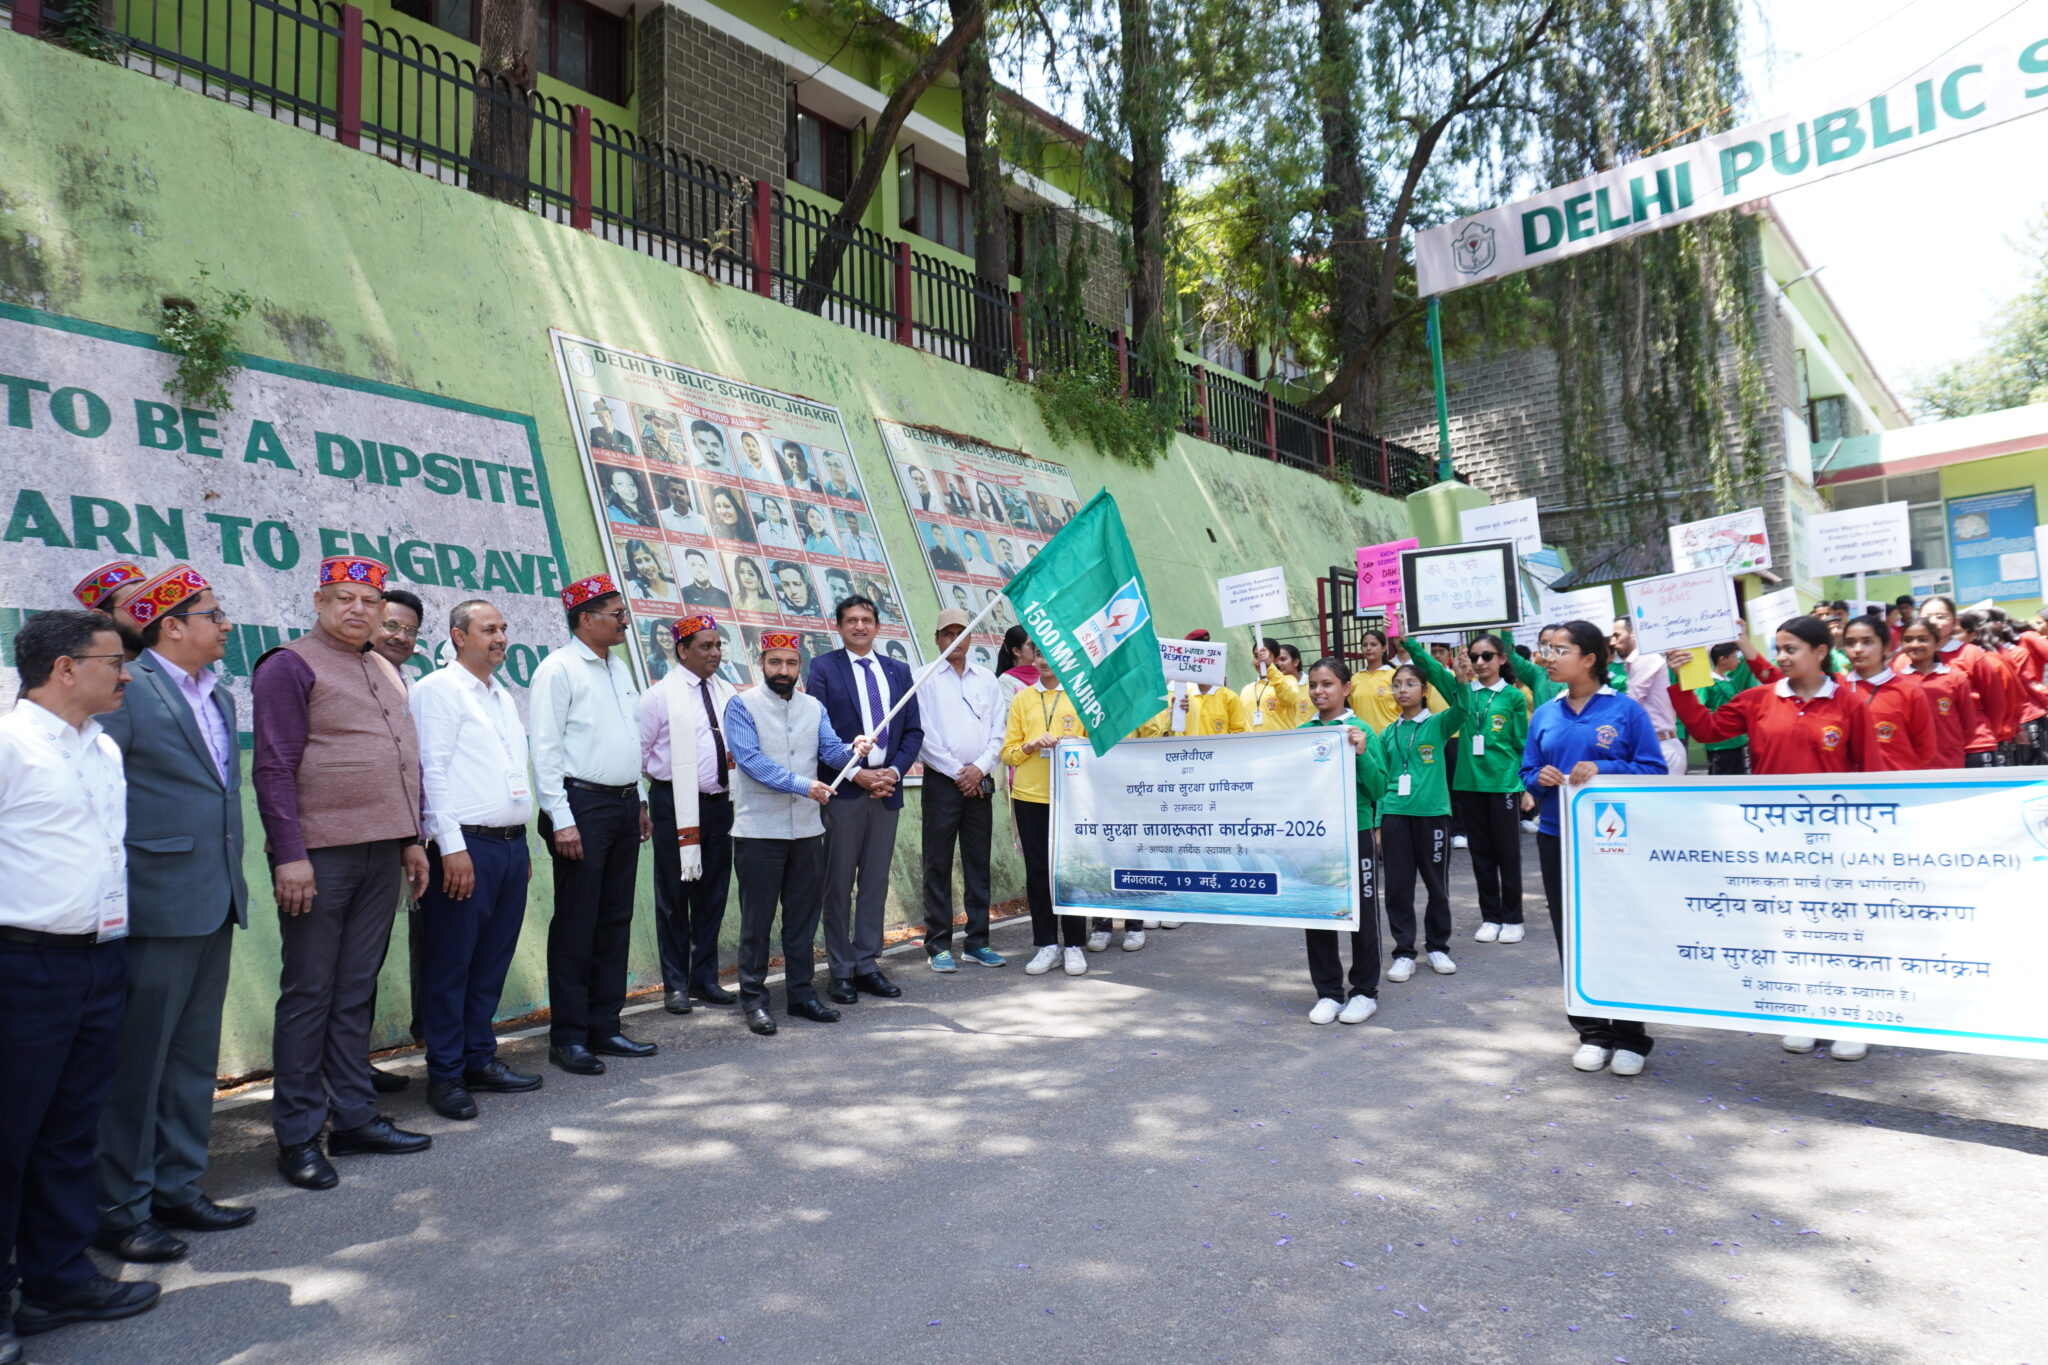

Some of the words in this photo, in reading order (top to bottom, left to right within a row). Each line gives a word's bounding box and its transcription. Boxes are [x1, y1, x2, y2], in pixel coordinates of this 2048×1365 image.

[1521, 161, 1694, 255] DELHI
[1719, 64, 1986, 196] PUBLIC
[594, 349, 647, 374] DELHI
[651, 365, 714, 391] PUBLIC
[718, 383, 781, 410] SCHOOL
[784, 402, 837, 424] JHAKRI
[683, 403, 701, 416] OUR
[702, 410, 729, 424] PROUD
[0, 373, 111, 438] TO
[134, 398, 223, 459] BE
[243, 419, 297, 470] A
[314, 431, 540, 509] DIPSITE
[902, 427, 939, 445] DELHI
[942, 436, 984, 456] PUBLIC
[986, 446, 1031, 467] SCHOOL
[1031, 460, 1068, 477] JHAKRI
[3, 488, 189, 560] ARN
[206, 513, 300, 571] TO
[318, 528, 562, 598] ENGRAVE
[1163, 652, 1191, 663] RESPECT
[1168, 645, 1183, 654] THE
[1024, 600, 1061, 647] 1500
[1048, 640, 1080, 673] MW
[1068, 671, 1105, 729] NJHPS
[1179, 662, 1203, 672] LINES
[1165, 748, 1214, 763] एसजेवीएन
[1126, 781, 1155, 797] राष्ट्रीय
[1157, 780, 1175, 793] बांध
[1179, 783, 1205, 797] सुरक्षा
[1209, 778, 1254, 793] प्राधिकरण
[1160, 801, 1169, 812] के
[1174, 803, 1204, 813] समन्वय
[1208, 801, 1217, 812] में
[1739, 793, 1901, 834] एसजेवीएन
[1074, 818, 1099, 836] बांध
[1102, 823, 1139, 842] सुरक्षा
[1143, 823, 1214, 837] जागरूकता
[1804, 832, 1831, 845] द्वारा
[1136, 843, 1144, 853] में
[1149, 845, 1174, 854] आपका
[1178, 843, 1201, 855] हार्दिक
[1206, 846, 1232, 855] स्वागत
[1432, 829, 1444, 863] DPS
[1649, 849, 1759, 864] AWARENESS
[1765, 851, 1834, 865] MARCH
[1840, 852, 1885, 868] (JAN
[1893, 853, 2021, 872] BHAGIDARI)
[1121, 871, 1168, 887] मंगलवार,
[1176, 877, 1192, 887] 19
[1199, 873, 1221, 889] मई,
[1230, 878, 1267, 889] 2026
[1361, 858, 1374, 898] DPS
[1724, 876, 1790, 889] जागरूकता
[1685, 892, 1747, 919] राष्ट्रीय
[1751, 895, 1793, 915] बांध
[1798, 900, 1858, 924] सुरक्षा
[1864, 898, 1976, 922] प्राधिकरण
[1801, 930, 1849, 942] समन्वय
[1852, 928, 1865, 943] में
[1676, 941, 1716, 962] बांध
[1721, 947, 1777, 970] सुरक्षा
[1782, 950, 1892, 973] जागरूकता
[1898, 952, 1992, 979] कार्यक्रम
[1741, 976, 1753, 990] में
[1757, 980, 1801, 994] आपका
[1805, 980, 1847, 997] हार्दिक
[1851, 987, 1895, 1000] स्वागत
[1821, 1006, 1837, 1017] 19
[1841, 1004, 1861, 1020] मई
[1867, 1009, 1905, 1024] 2026
